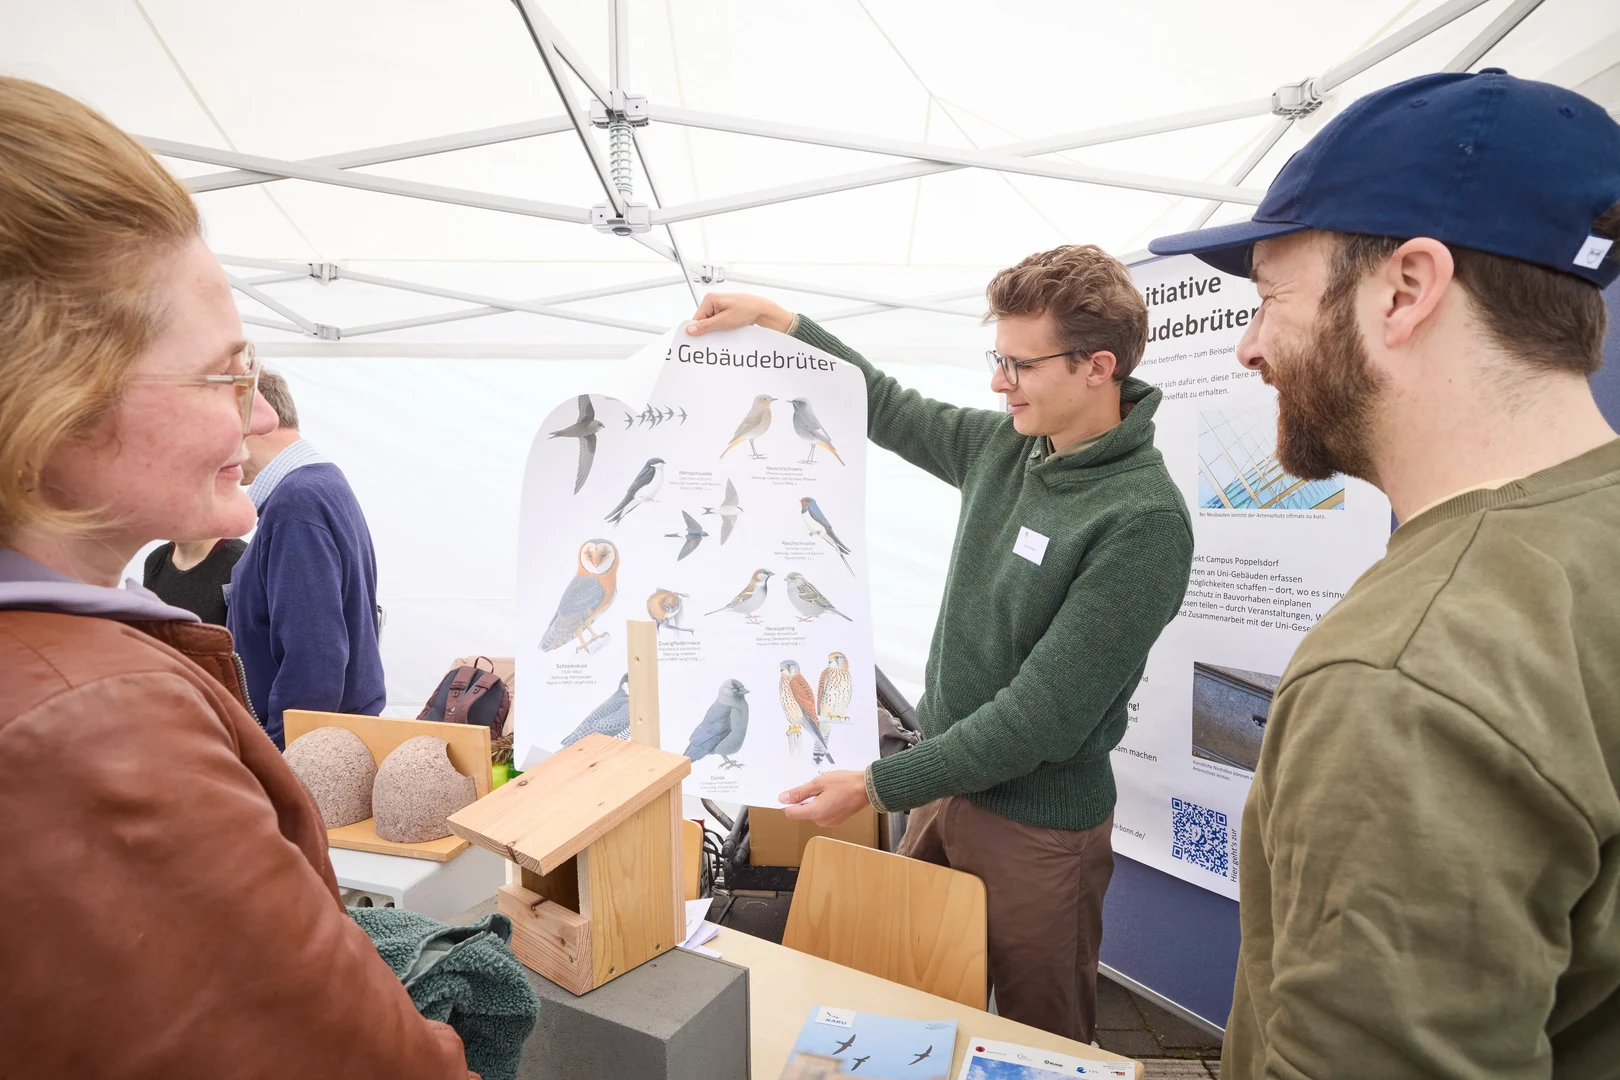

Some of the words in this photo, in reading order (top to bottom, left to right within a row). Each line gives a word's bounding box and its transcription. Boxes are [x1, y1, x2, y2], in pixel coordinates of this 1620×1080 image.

[1145, 276, 1222, 307] itiative
[1147, 307, 1260, 343] udebrüter
[678, 344, 837, 371] Gebäudebrüter
[1158, 353, 1188, 364] betroffen
[1193, 350, 1208, 359] zum
[1209, 345, 1236, 357] Beispiel
[1178, 376, 1196, 387] dafür
[1197, 376, 1209, 384] ein,
[1210, 373, 1229, 382] diese
[1231, 370, 1250, 379] Tiere
[1198, 388, 1230, 397] erhalten.
[1206, 555, 1234, 565] Campus
[1234, 557, 1280, 567] Poppelsdorf
[1191, 568, 1206, 576] rten
[1216, 569, 1269, 581] Uni-Gebäuden
[1269, 573, 1303, 583] erfassen
[1189, 579, 1235, 589] möglichkeiten
[1236, 583, 1267, 592] schaffen
[1275, 585, 1294, 596] dort,
[1321, 590, 1345, 599] sinnv
[1214, 591, 1222, 599] in
[1223, 592, 1271, 604] Bauvorhaben
[1272, 597, 1312, 608] einplanen
[1199, 601, 1218, 610] teilen
[1225, 604, 1246, 613] durch
[1247, 606, 1313, 622] Veranstaltungen,
[1188, 610, 1245, 625] Zusammenarbeit
[1246, 618, 1259, 627] mit
[1260, 619, 1274, 628] der
[1275, 621, 1314, 633] Uni-Gese
[1128, 702, 1140, 711] ng!
[1129, 748, 1158, 762] machen
